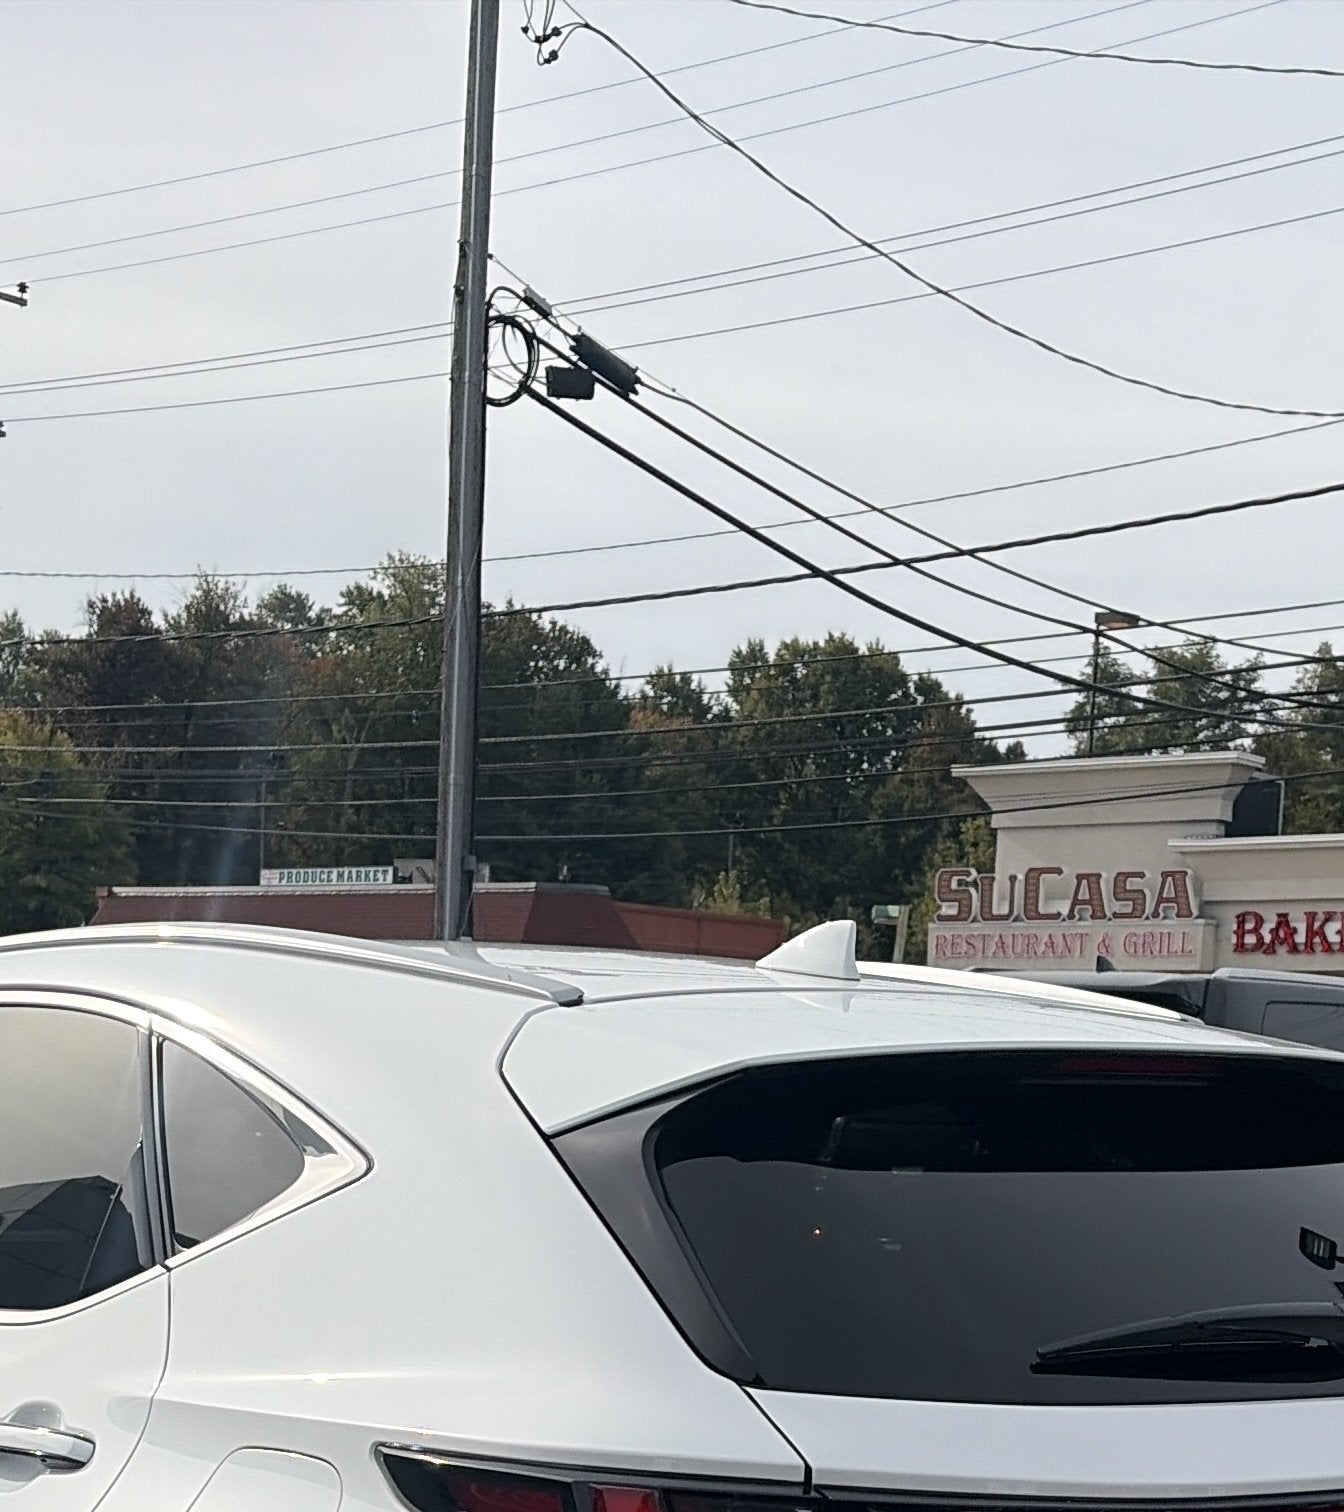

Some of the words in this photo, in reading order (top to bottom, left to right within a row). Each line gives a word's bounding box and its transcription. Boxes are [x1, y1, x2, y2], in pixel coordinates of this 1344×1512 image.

[278, 870, 334, 884] PRODUCE
[336, 868, 390, 883] MARKET
[934, 931, 1091, 957] RESTAURANT
[1097, 935, 1113, 956] &
[1122, 931, 1194, 956] GRILL
